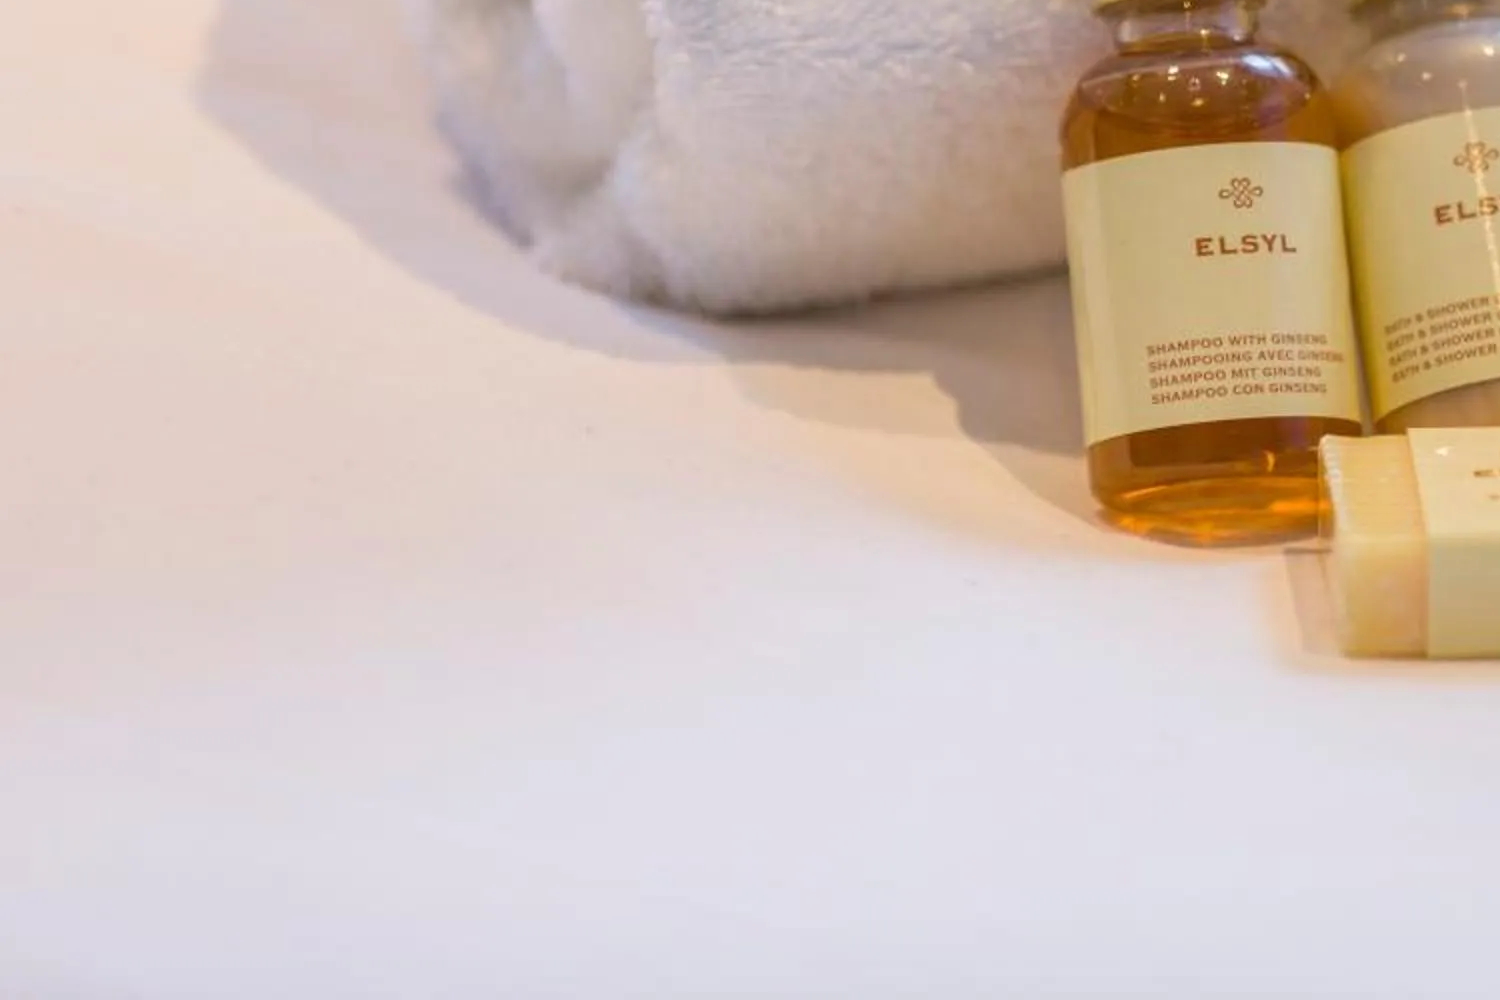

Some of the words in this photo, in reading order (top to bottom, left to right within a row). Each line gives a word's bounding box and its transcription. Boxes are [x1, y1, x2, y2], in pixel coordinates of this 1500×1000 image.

[1194, 233, 1297, 257] ELSYL
[1426, 296, 1490, 319] SHOWER
[1429, 311, 1492, 335] SHOWER
[1147, 337, 1223, 356] SHAMPOO
[1228, 334, 1267, 346] WITH
[1431, 327, 1495, 351] SHOWER
[1148, 351, 1253, 373] SHAMPOOING
[1258, 349, 1295, 361] AVEC
[1434, 343, 1498, 367] SHOWER
[1150, 370, 1226, 389] SHAMPOO
[1230, 367, 1257, 379] MIT
[1262, 366, 1321, 378] GINSENG
[1151, 386, 1228, 405] SHAMPOO
[1232, 383, 1265, 396] CON
[1268, 383, 1327, 394] GINSENG
